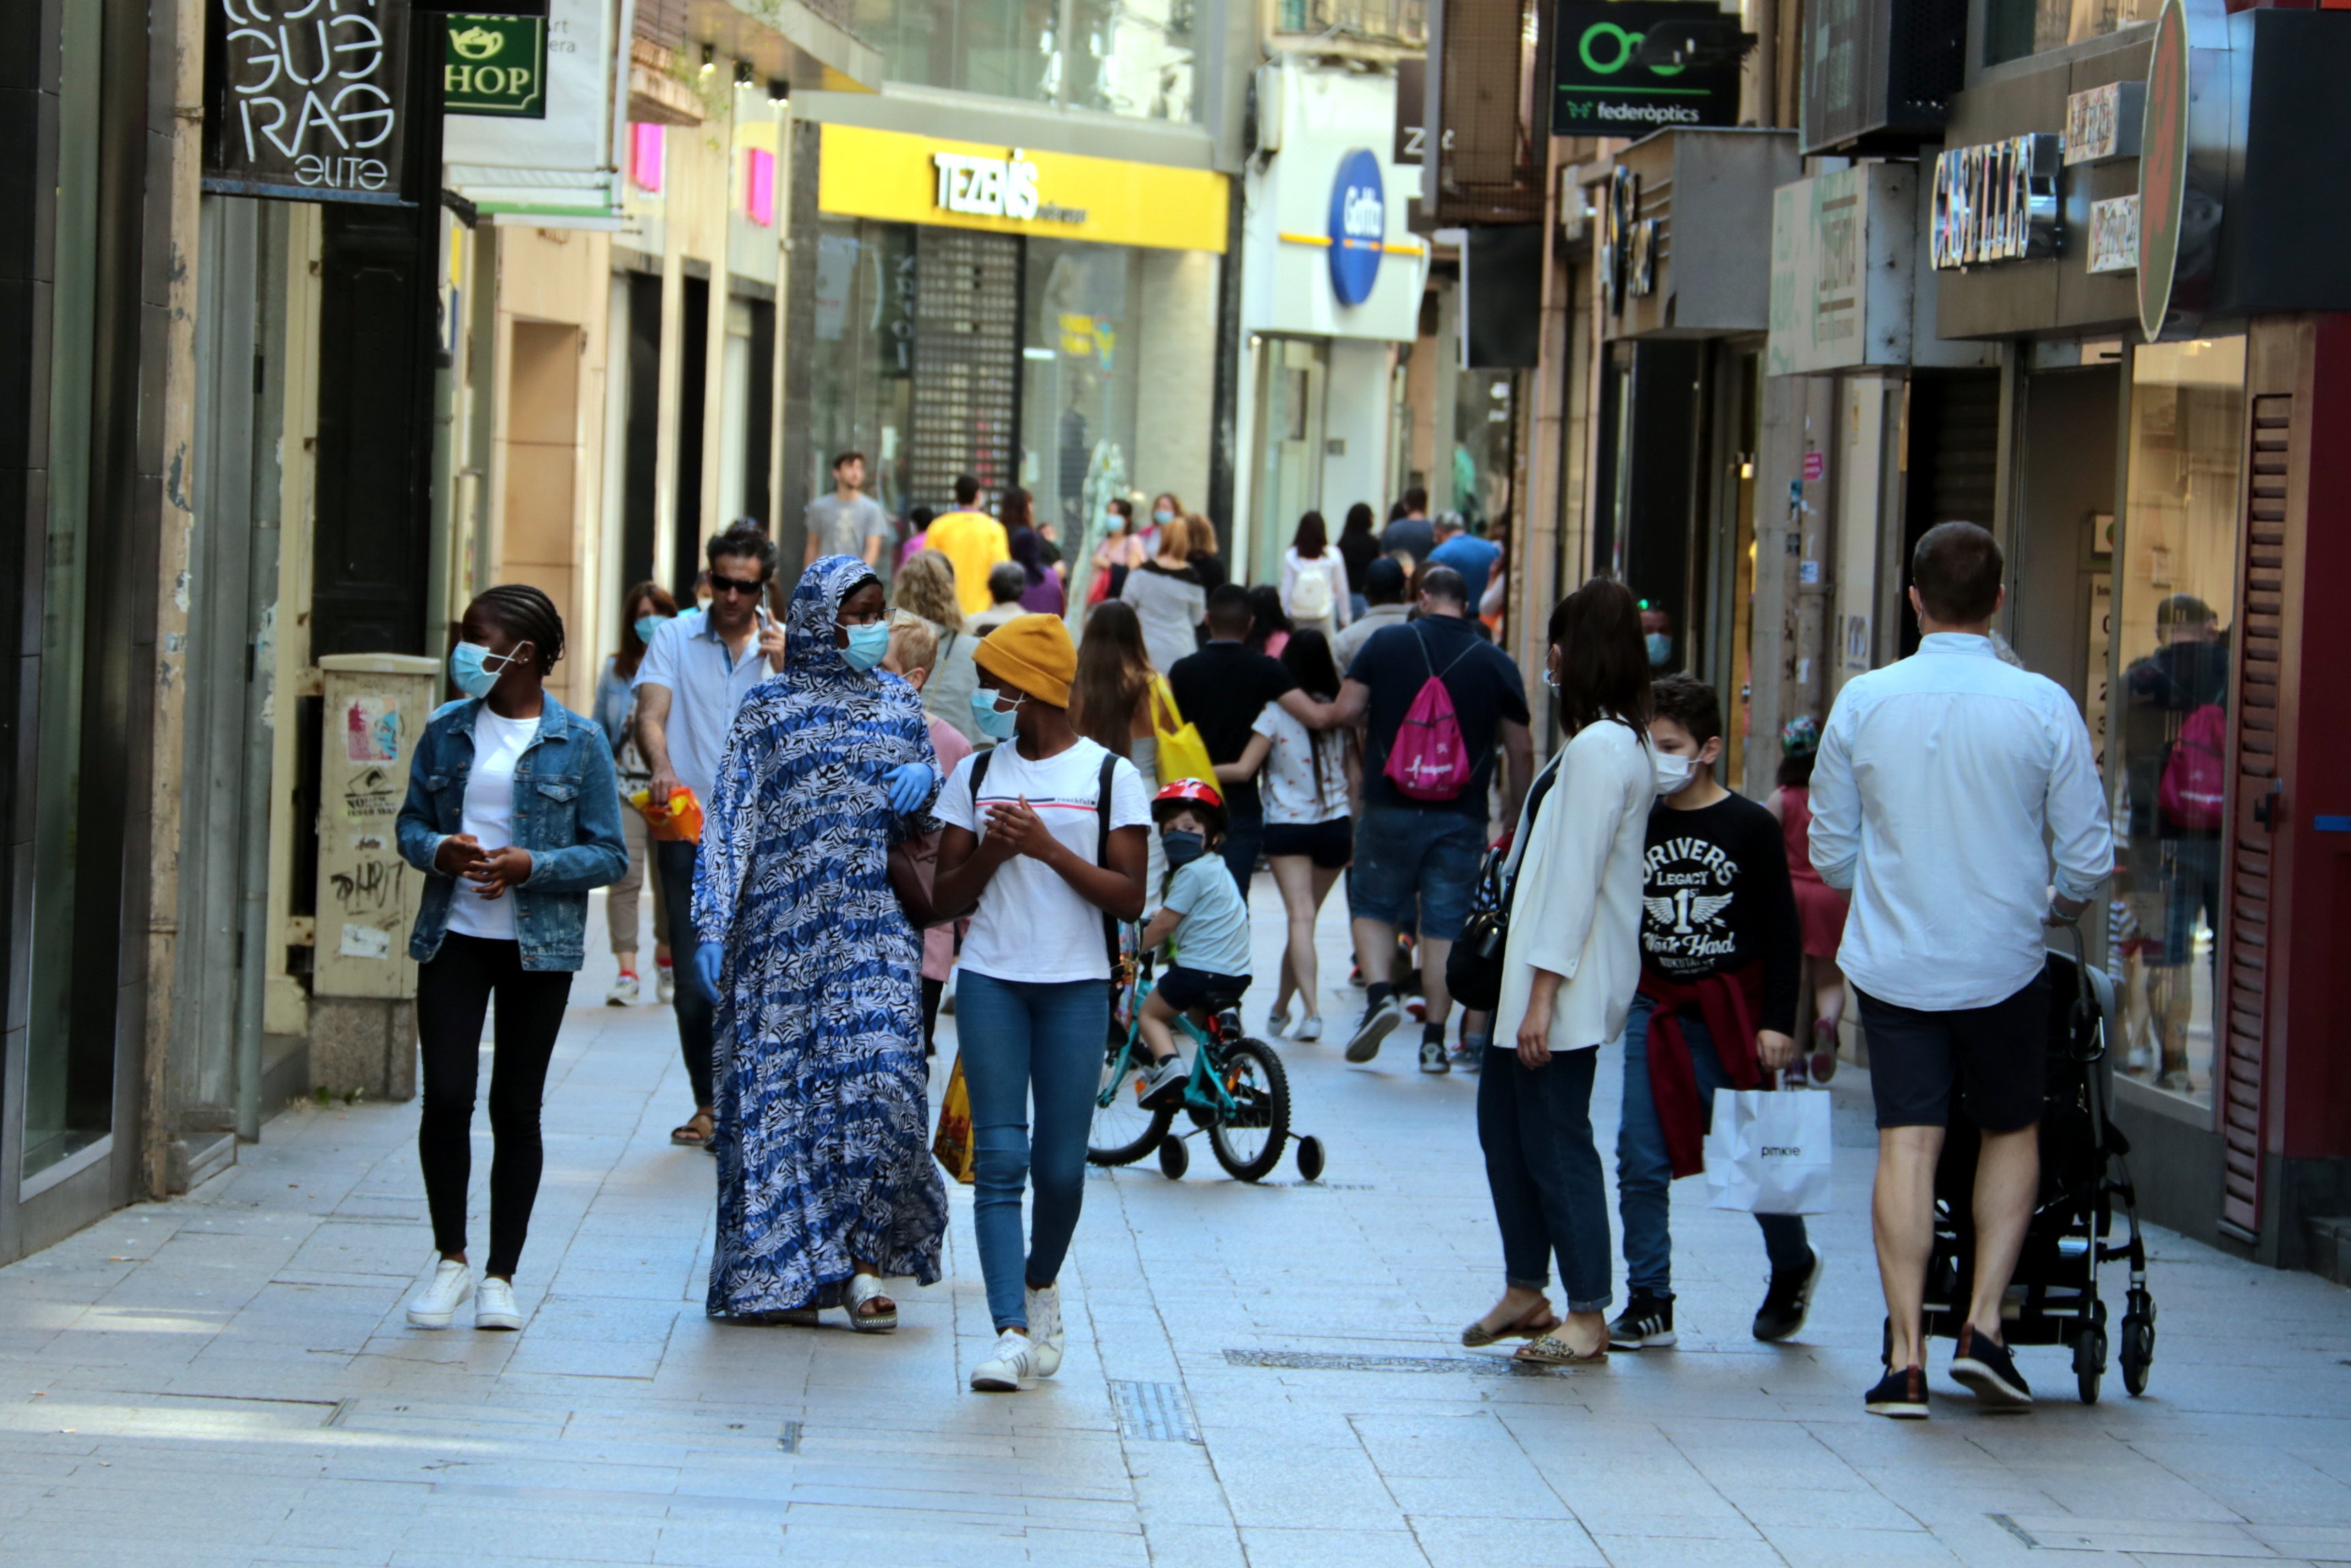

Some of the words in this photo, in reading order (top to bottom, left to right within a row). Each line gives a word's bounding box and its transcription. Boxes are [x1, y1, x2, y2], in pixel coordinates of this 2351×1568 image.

[444, 64, 530, 95] HOP
[1598, 101, 1700, 124] federòptics
[1656, 871, 1709, 886] LEGACY
[1681, 931, 1736, 957] Hard
[1761, 1146, 1801, 1159] pimkie
